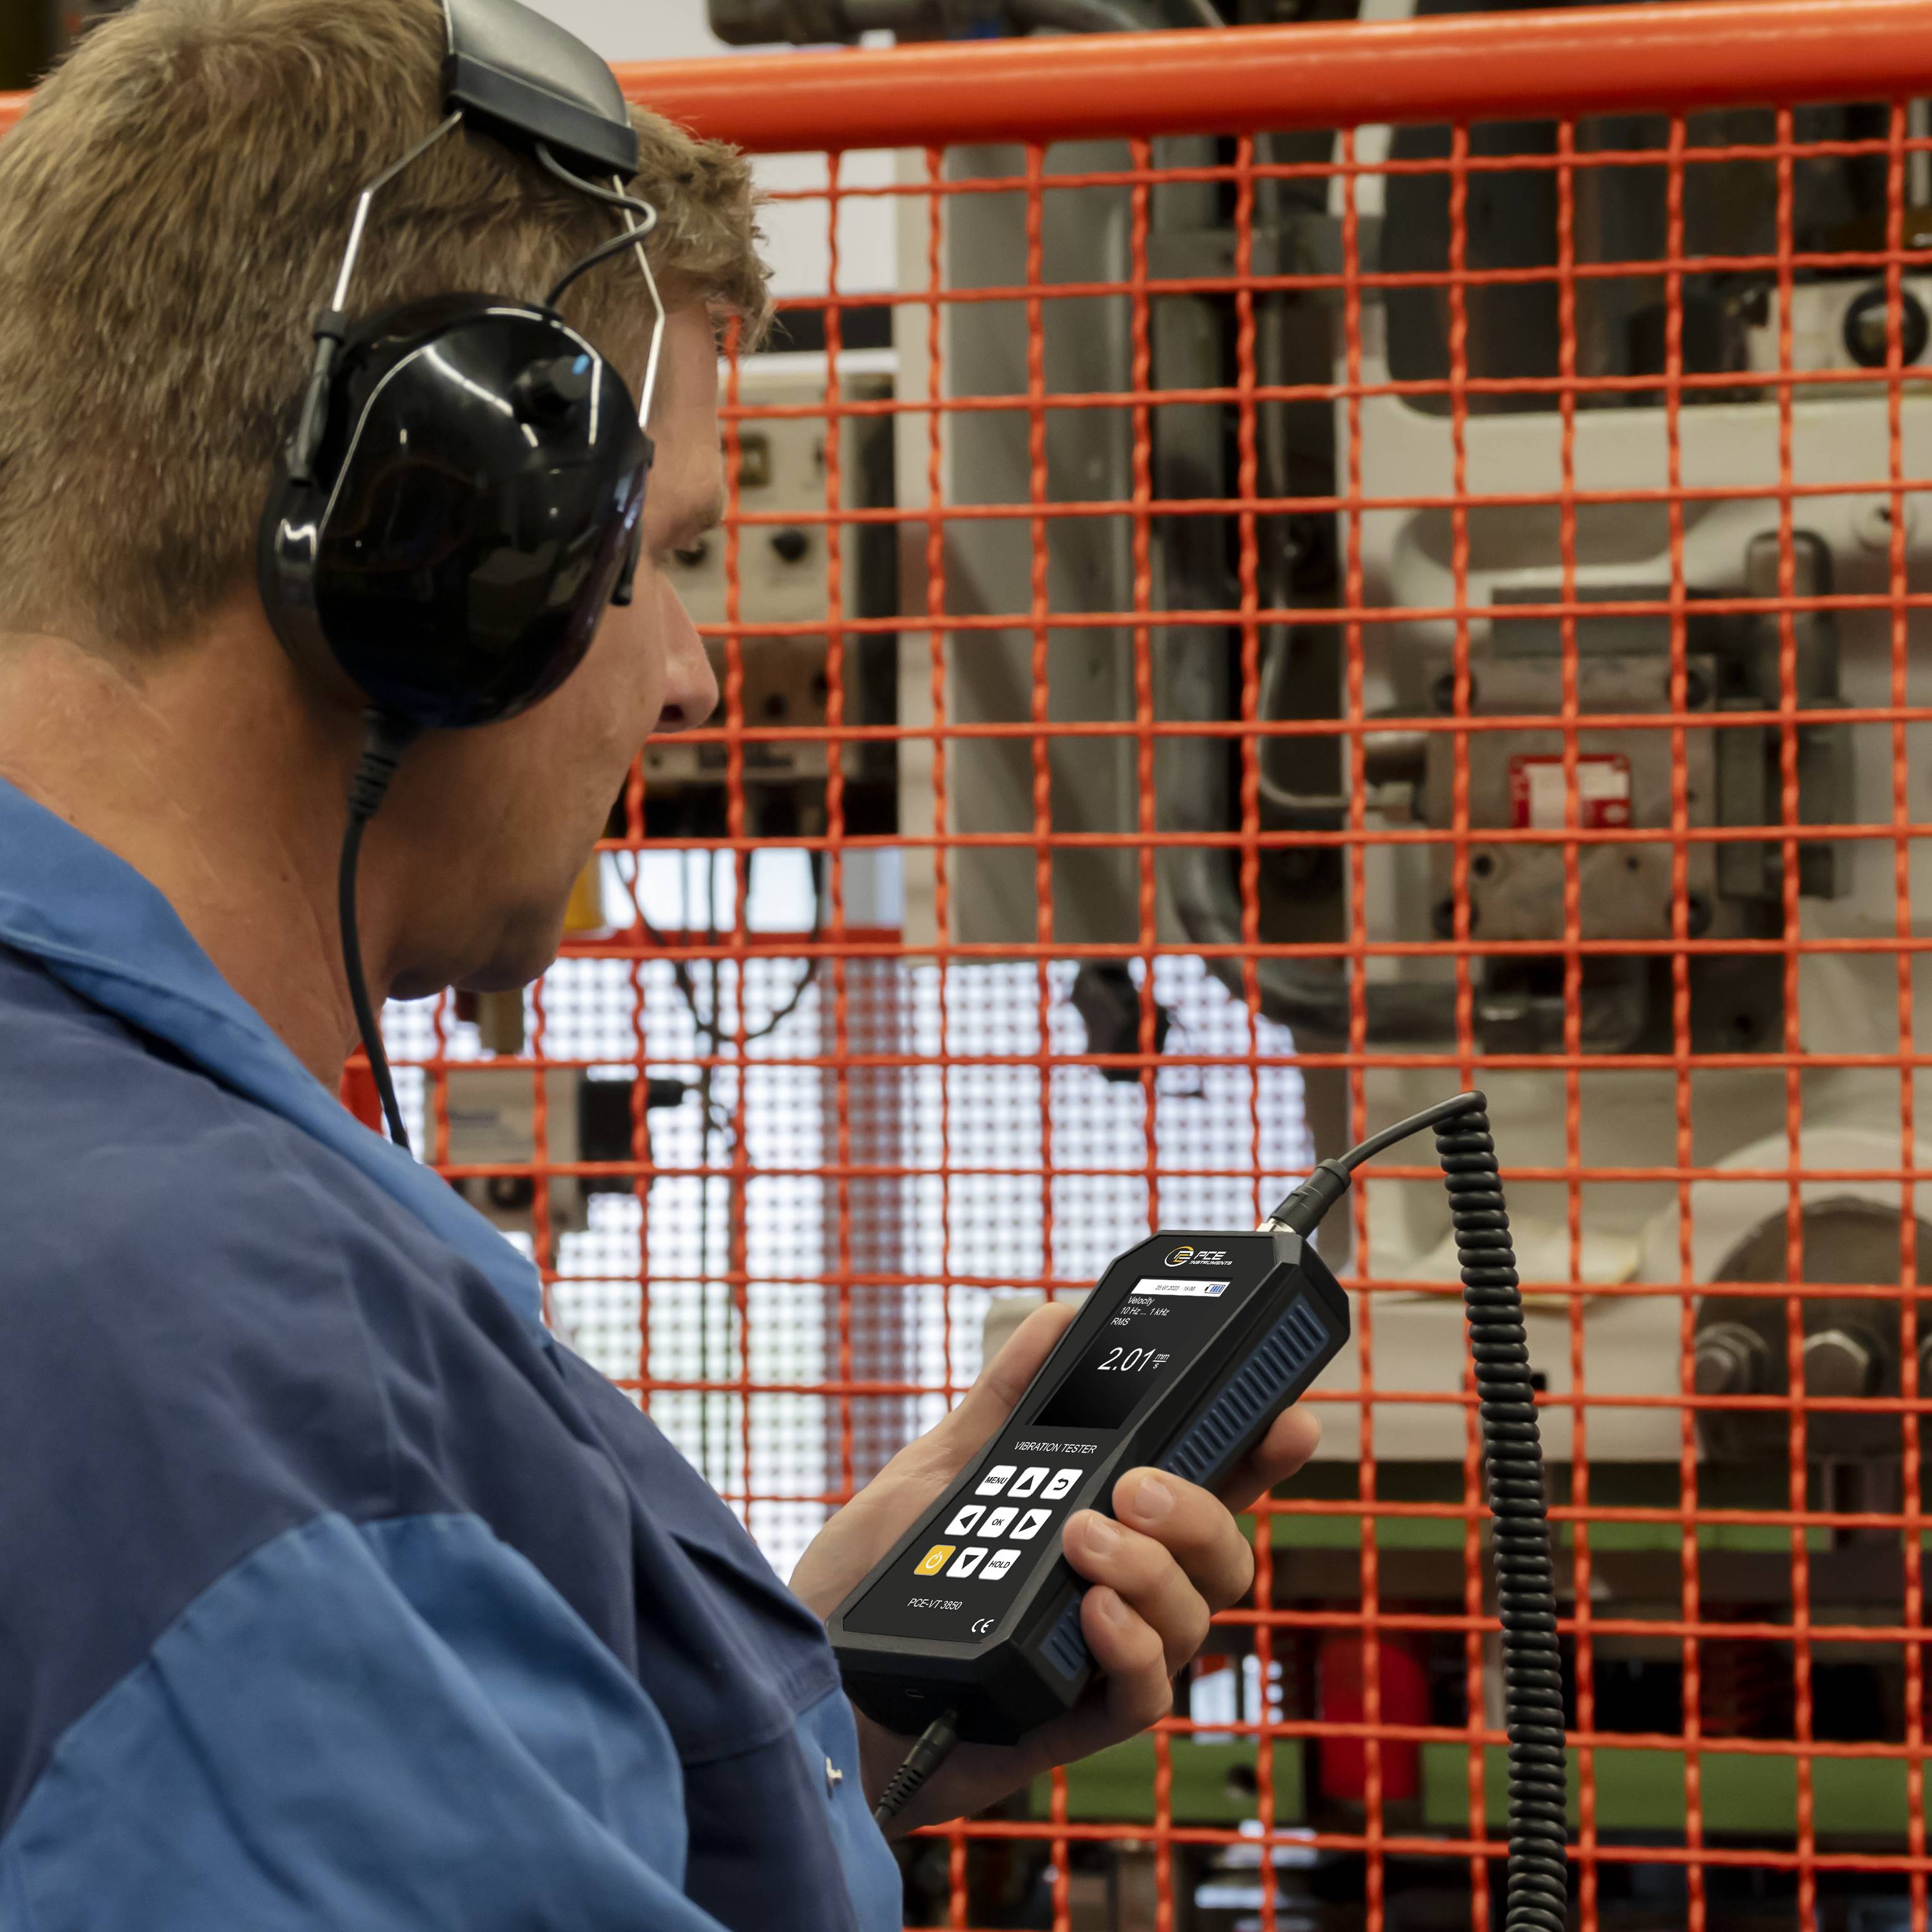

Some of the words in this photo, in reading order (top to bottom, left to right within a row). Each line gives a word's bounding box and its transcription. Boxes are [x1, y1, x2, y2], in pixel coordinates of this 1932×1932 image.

[1194, 1251, 1227, 1260] PCE
[1128, 1296, 1155, 1306] Velocity
[1121, 1306, 1131, 1314] 10
[1154, 1308, 1170, 1316] kHz
[1111, 1317, 1131, 1326] RMS
[1097, 1347, 1156, 1372] 2.01
[1014, 1441, 1062, 1452] VIBRATION
[1061, 1443, 1097, 1454] TESTER
[988, 1560, 1010, 1568] HOLD
[907, 1598, 943, 1609] PCE-VT
[940, 1600, 963, 1610] 3850
[971, 1618, 995, 1634] CE
